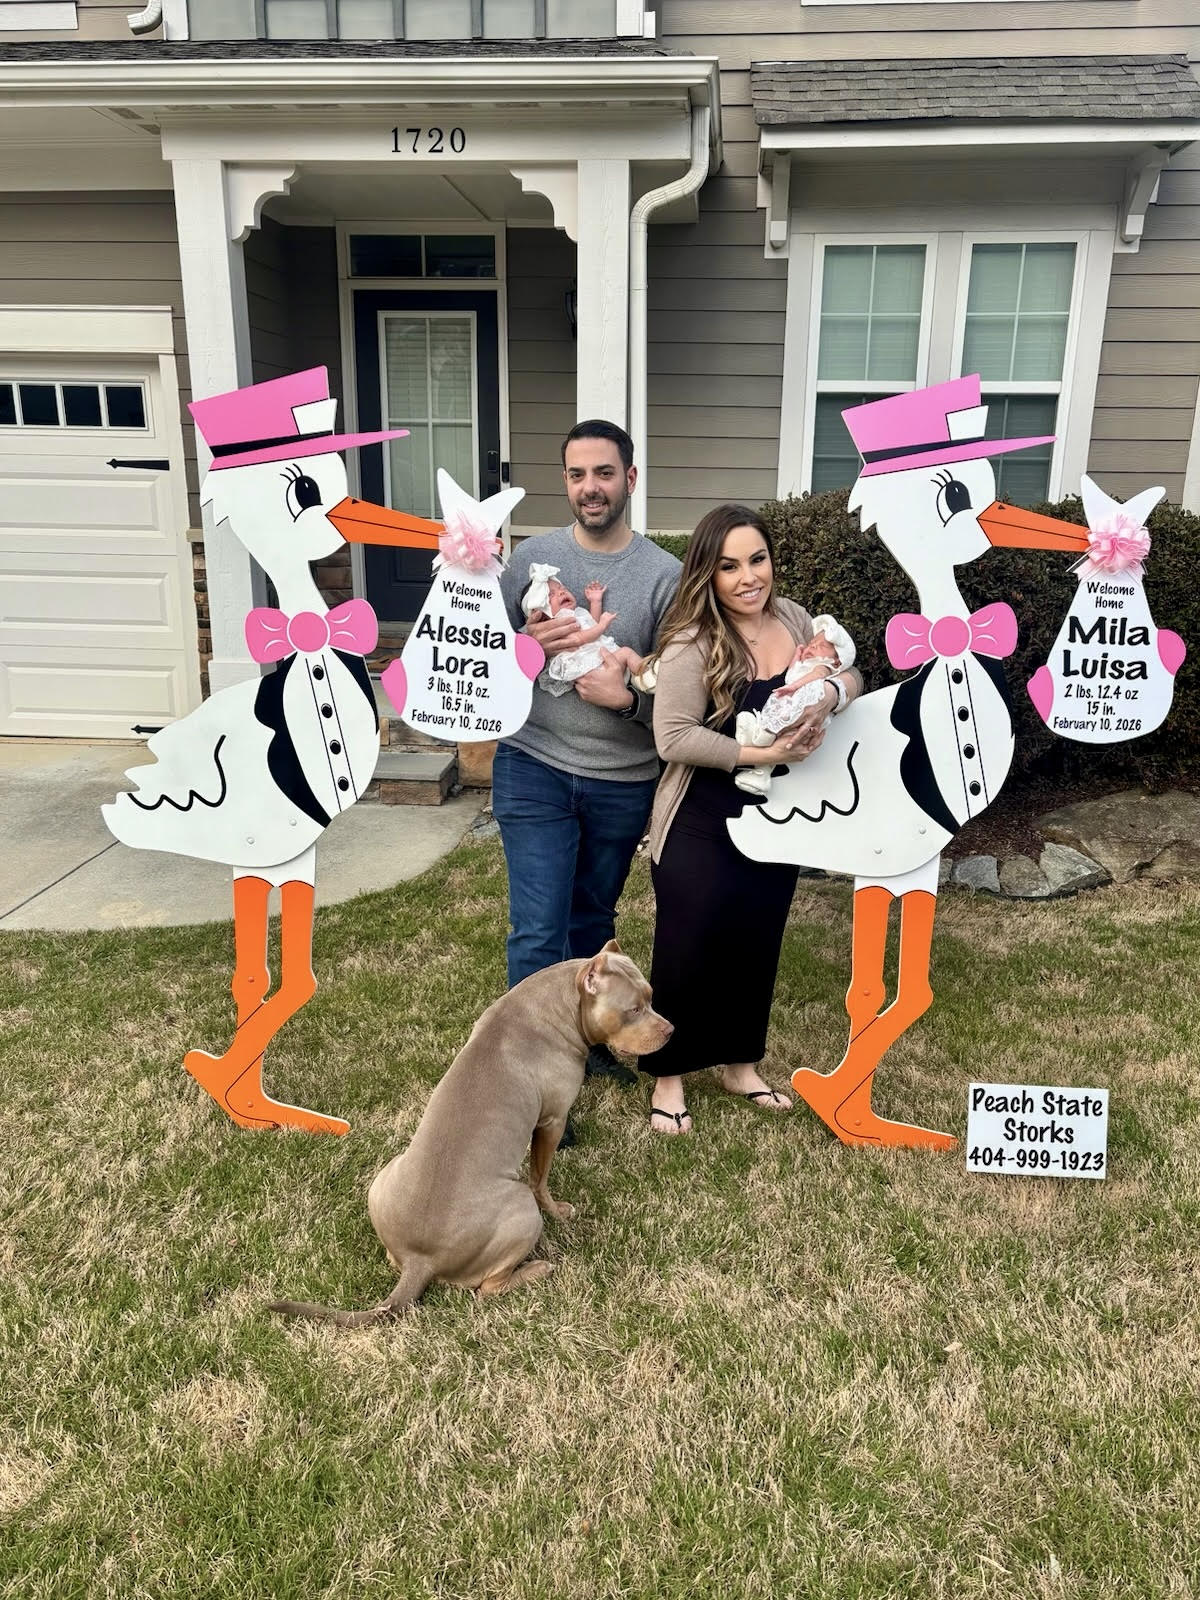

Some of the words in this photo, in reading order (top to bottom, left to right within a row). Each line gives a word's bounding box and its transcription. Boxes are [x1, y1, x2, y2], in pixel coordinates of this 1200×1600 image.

[391, 126, 466, 154] 1720
[442, 580, 493, 600] Welcome
[1086, 581, 1135, 596] Welcome
[450, 596, 481, 612] Home
[1095, 595, 1124, 610] Home
[415, 613, 507, 650] Alessia
[1067, 615, 1151, 647] Mila
[431, 645, 490, 679] Lora
[1062, 649, 1149, 681] Luisa
[427, 676, 435, 691] 3
[437, 677, 453, 694] lbs.
[456, 679, 474, 696] 11.8
[475, 686, 490, 699] oz.
[1063, 683, 1073, 698] 2
[1075, 684, 1094, 699] lbs.
[1097, 684, 1122, 700] 12.4
[1124, 689, 1139, 700] oz
[442, 695, 462, 712] 16.5
[464, 699, 476, 714] in.
[1087, 700, 1100, 716] 15
[1102, 702, 1116, 716] in.
[411, 708, 456, 729] February
[474, 717, 502, 733] 2026
[1053, 716, 1097, 732] February
[1099, 717, 1113, 732] 10,
[1114, 718, 1142, 732] 2026
[972, 1087, 1034, 1115] Peach
[1041, 1090, 1103, 1117] State
[1002, 1117, 1075, 1145] Storks
[968, 1146, 1105, 1172] 404-999-1923
